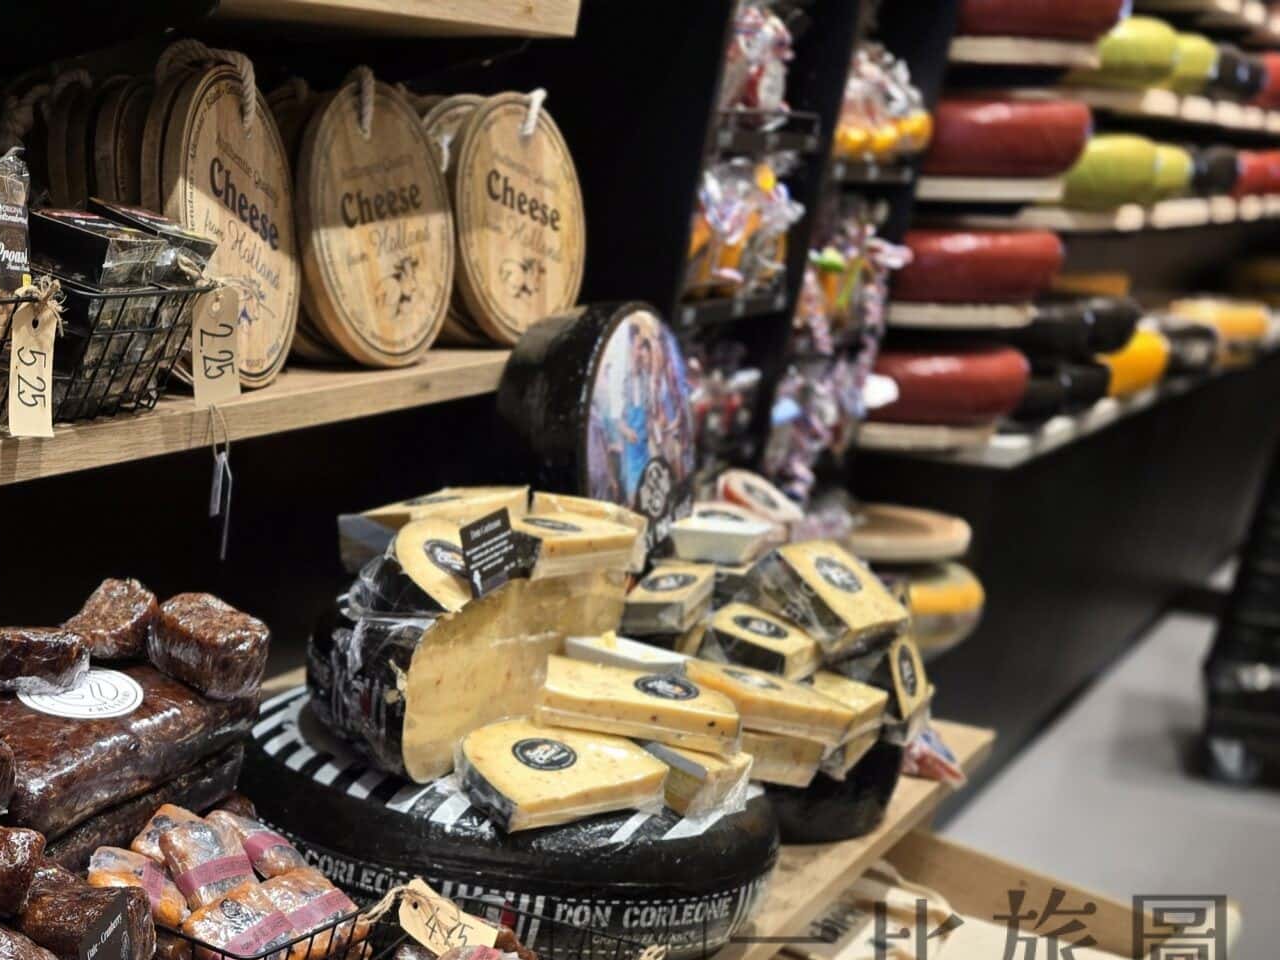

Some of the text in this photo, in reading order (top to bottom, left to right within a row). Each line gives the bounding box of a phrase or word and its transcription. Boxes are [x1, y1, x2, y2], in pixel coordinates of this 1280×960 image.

[209, 157, 280, 250] Cheese
[340, 183, 422, 229] Cheese
[486, 168, 562, 232] Cheese
[227, 219, 281, 290] Holland
[16, 346, 46, 408] 5.25
[200, 323, 235, 380] 2.25
[554, 896, 734, 928] DON CORLEONE
